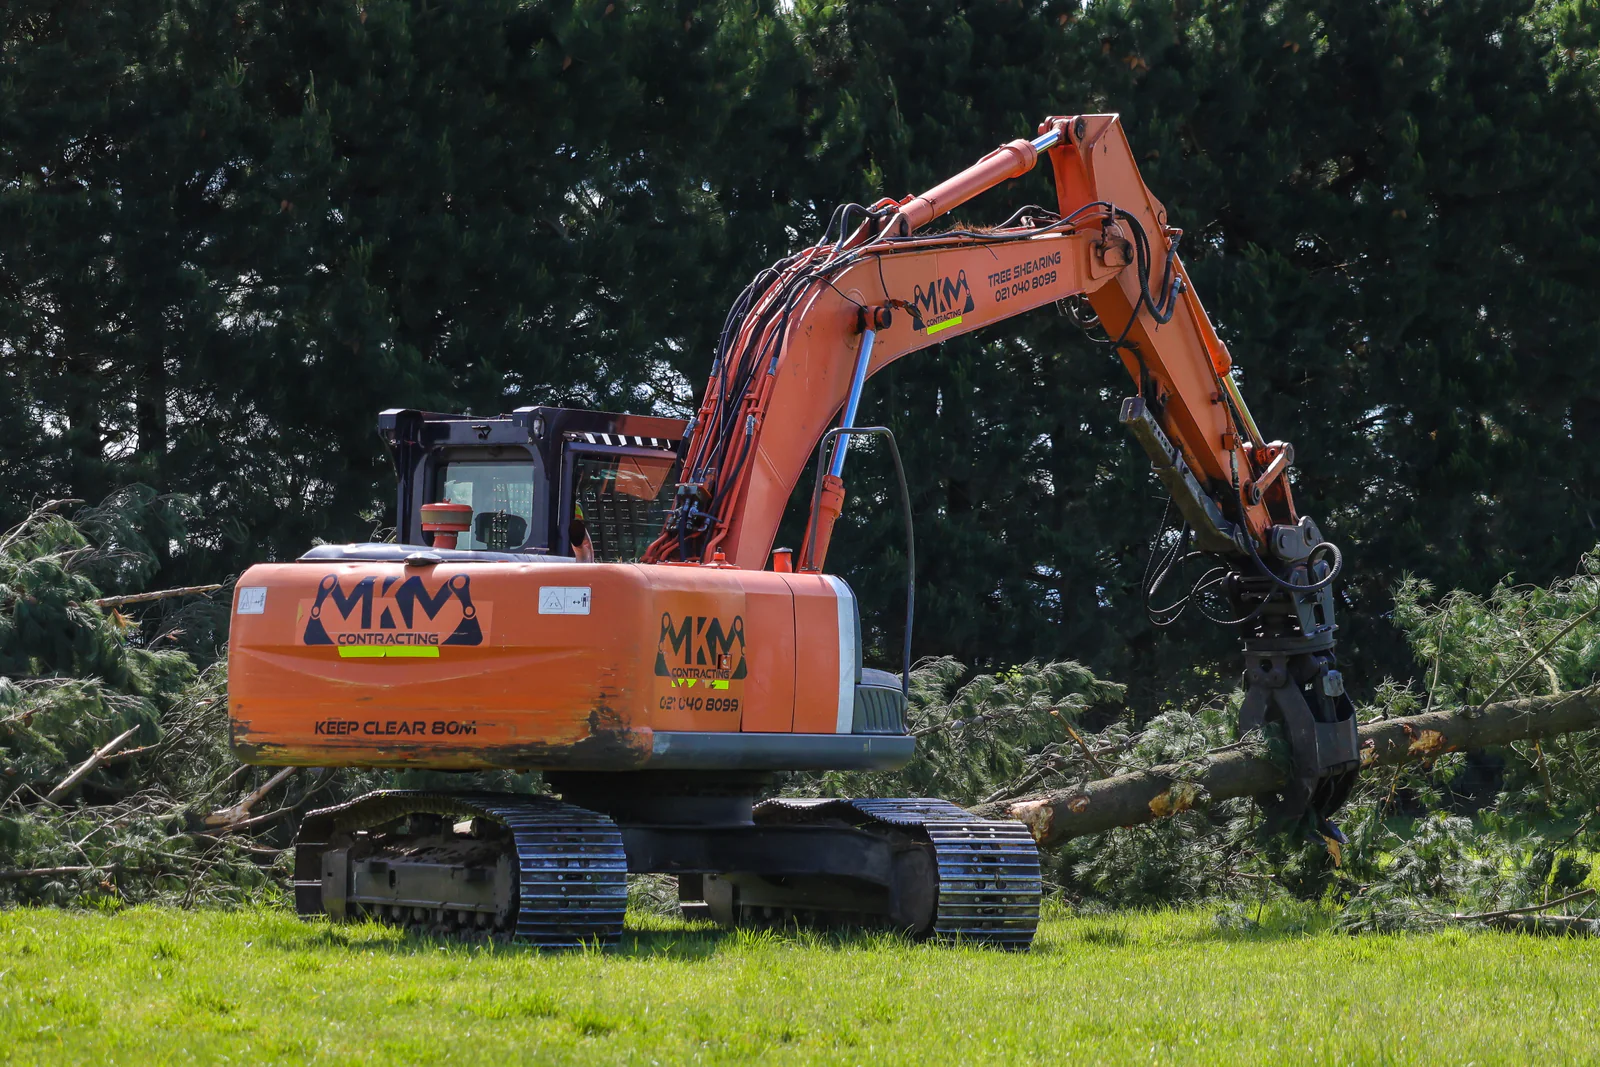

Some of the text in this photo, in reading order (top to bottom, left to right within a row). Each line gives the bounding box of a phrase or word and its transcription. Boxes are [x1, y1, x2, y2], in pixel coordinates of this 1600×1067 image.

[988, 251, 1061, 287] TREE SHEARING
[995, 270, 1057, 302] 021 040 8099
[926, 308, 962, 327] CONTRACTING
[309, 574, 479, 630] MKM
[337, 632, 439, 645] CONTRACTING
[657, 611, 746, 666] MKM
[671, 667, 730, 679] CONTRACTING
[705, 698, 739, 712] 8099
[314, 720, 359, 735] KEEP
[363, 720, 427, 735] CLEAR
